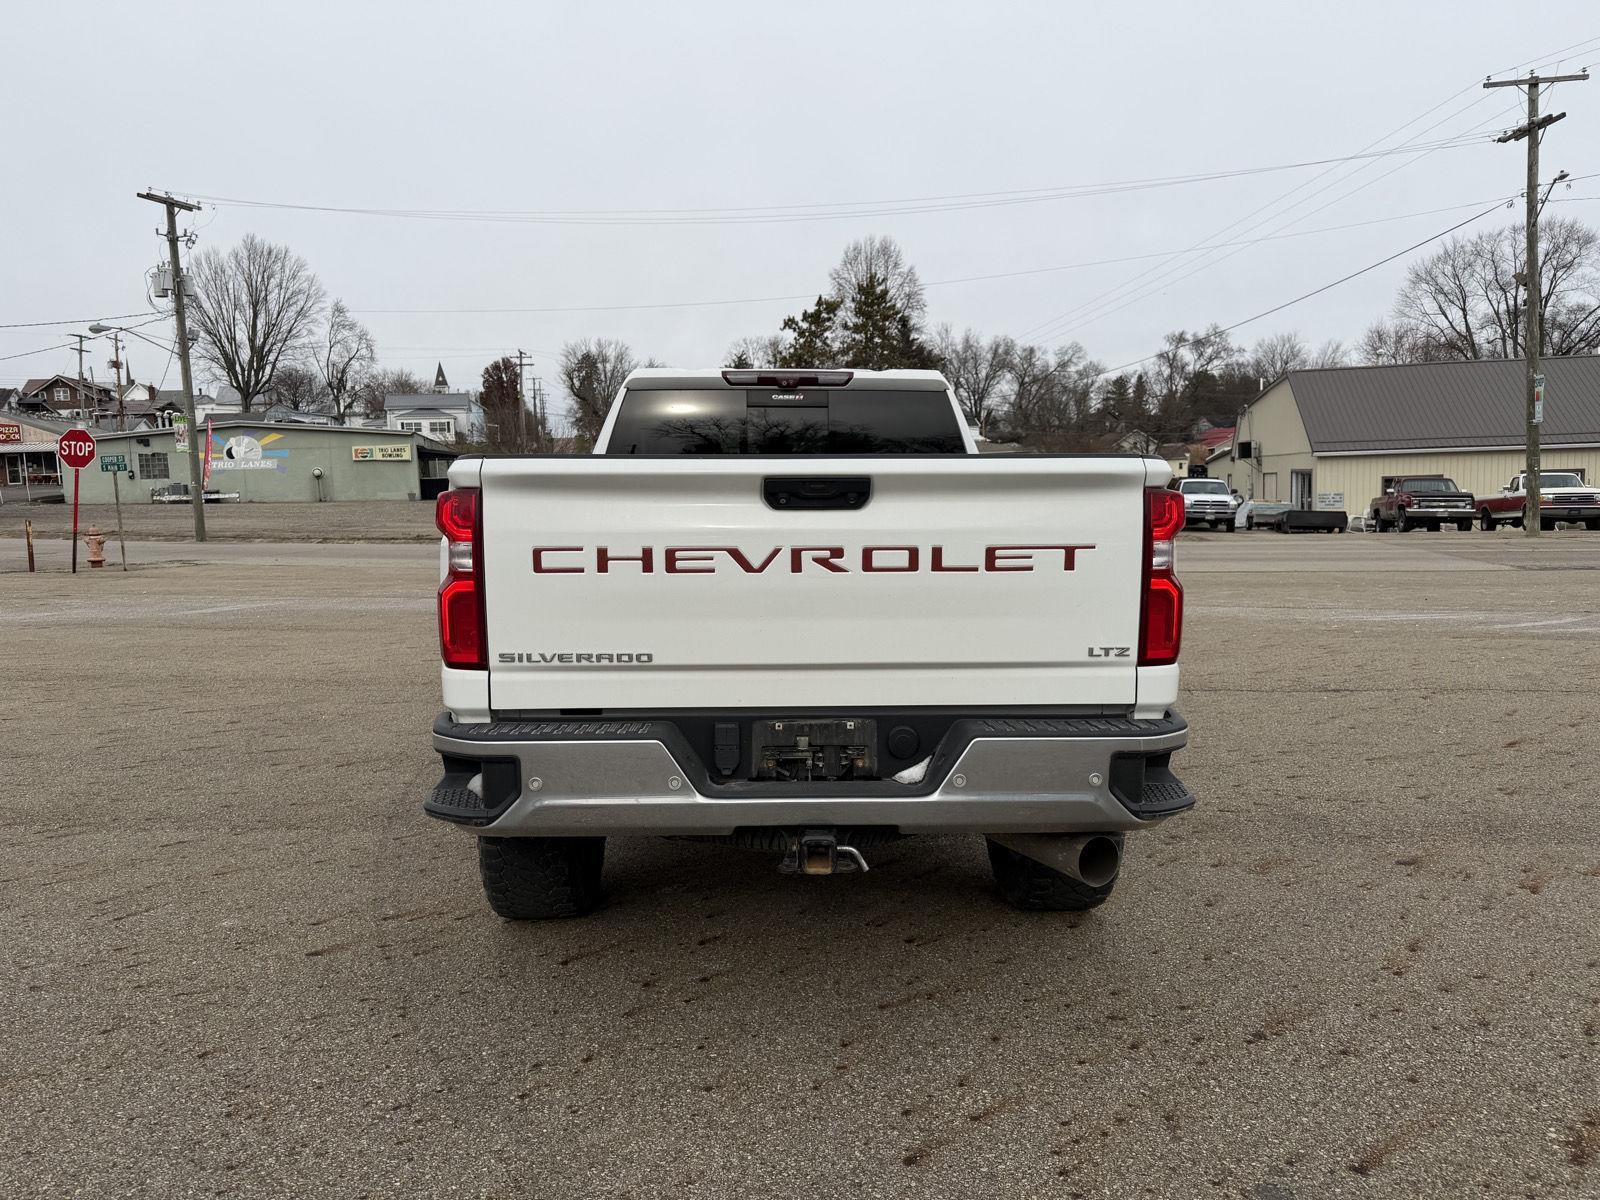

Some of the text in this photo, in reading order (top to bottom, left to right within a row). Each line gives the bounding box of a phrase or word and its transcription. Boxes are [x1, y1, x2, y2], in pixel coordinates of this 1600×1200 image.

[61, 441, 93, 456] STOP
[212, 461, 234, 469] TRIO
[532, 544, 1096, 574] CHEVROLET
[498, 652, 654, 663] SILVERADO
[1087, 647, 1131, 658] LTZ
